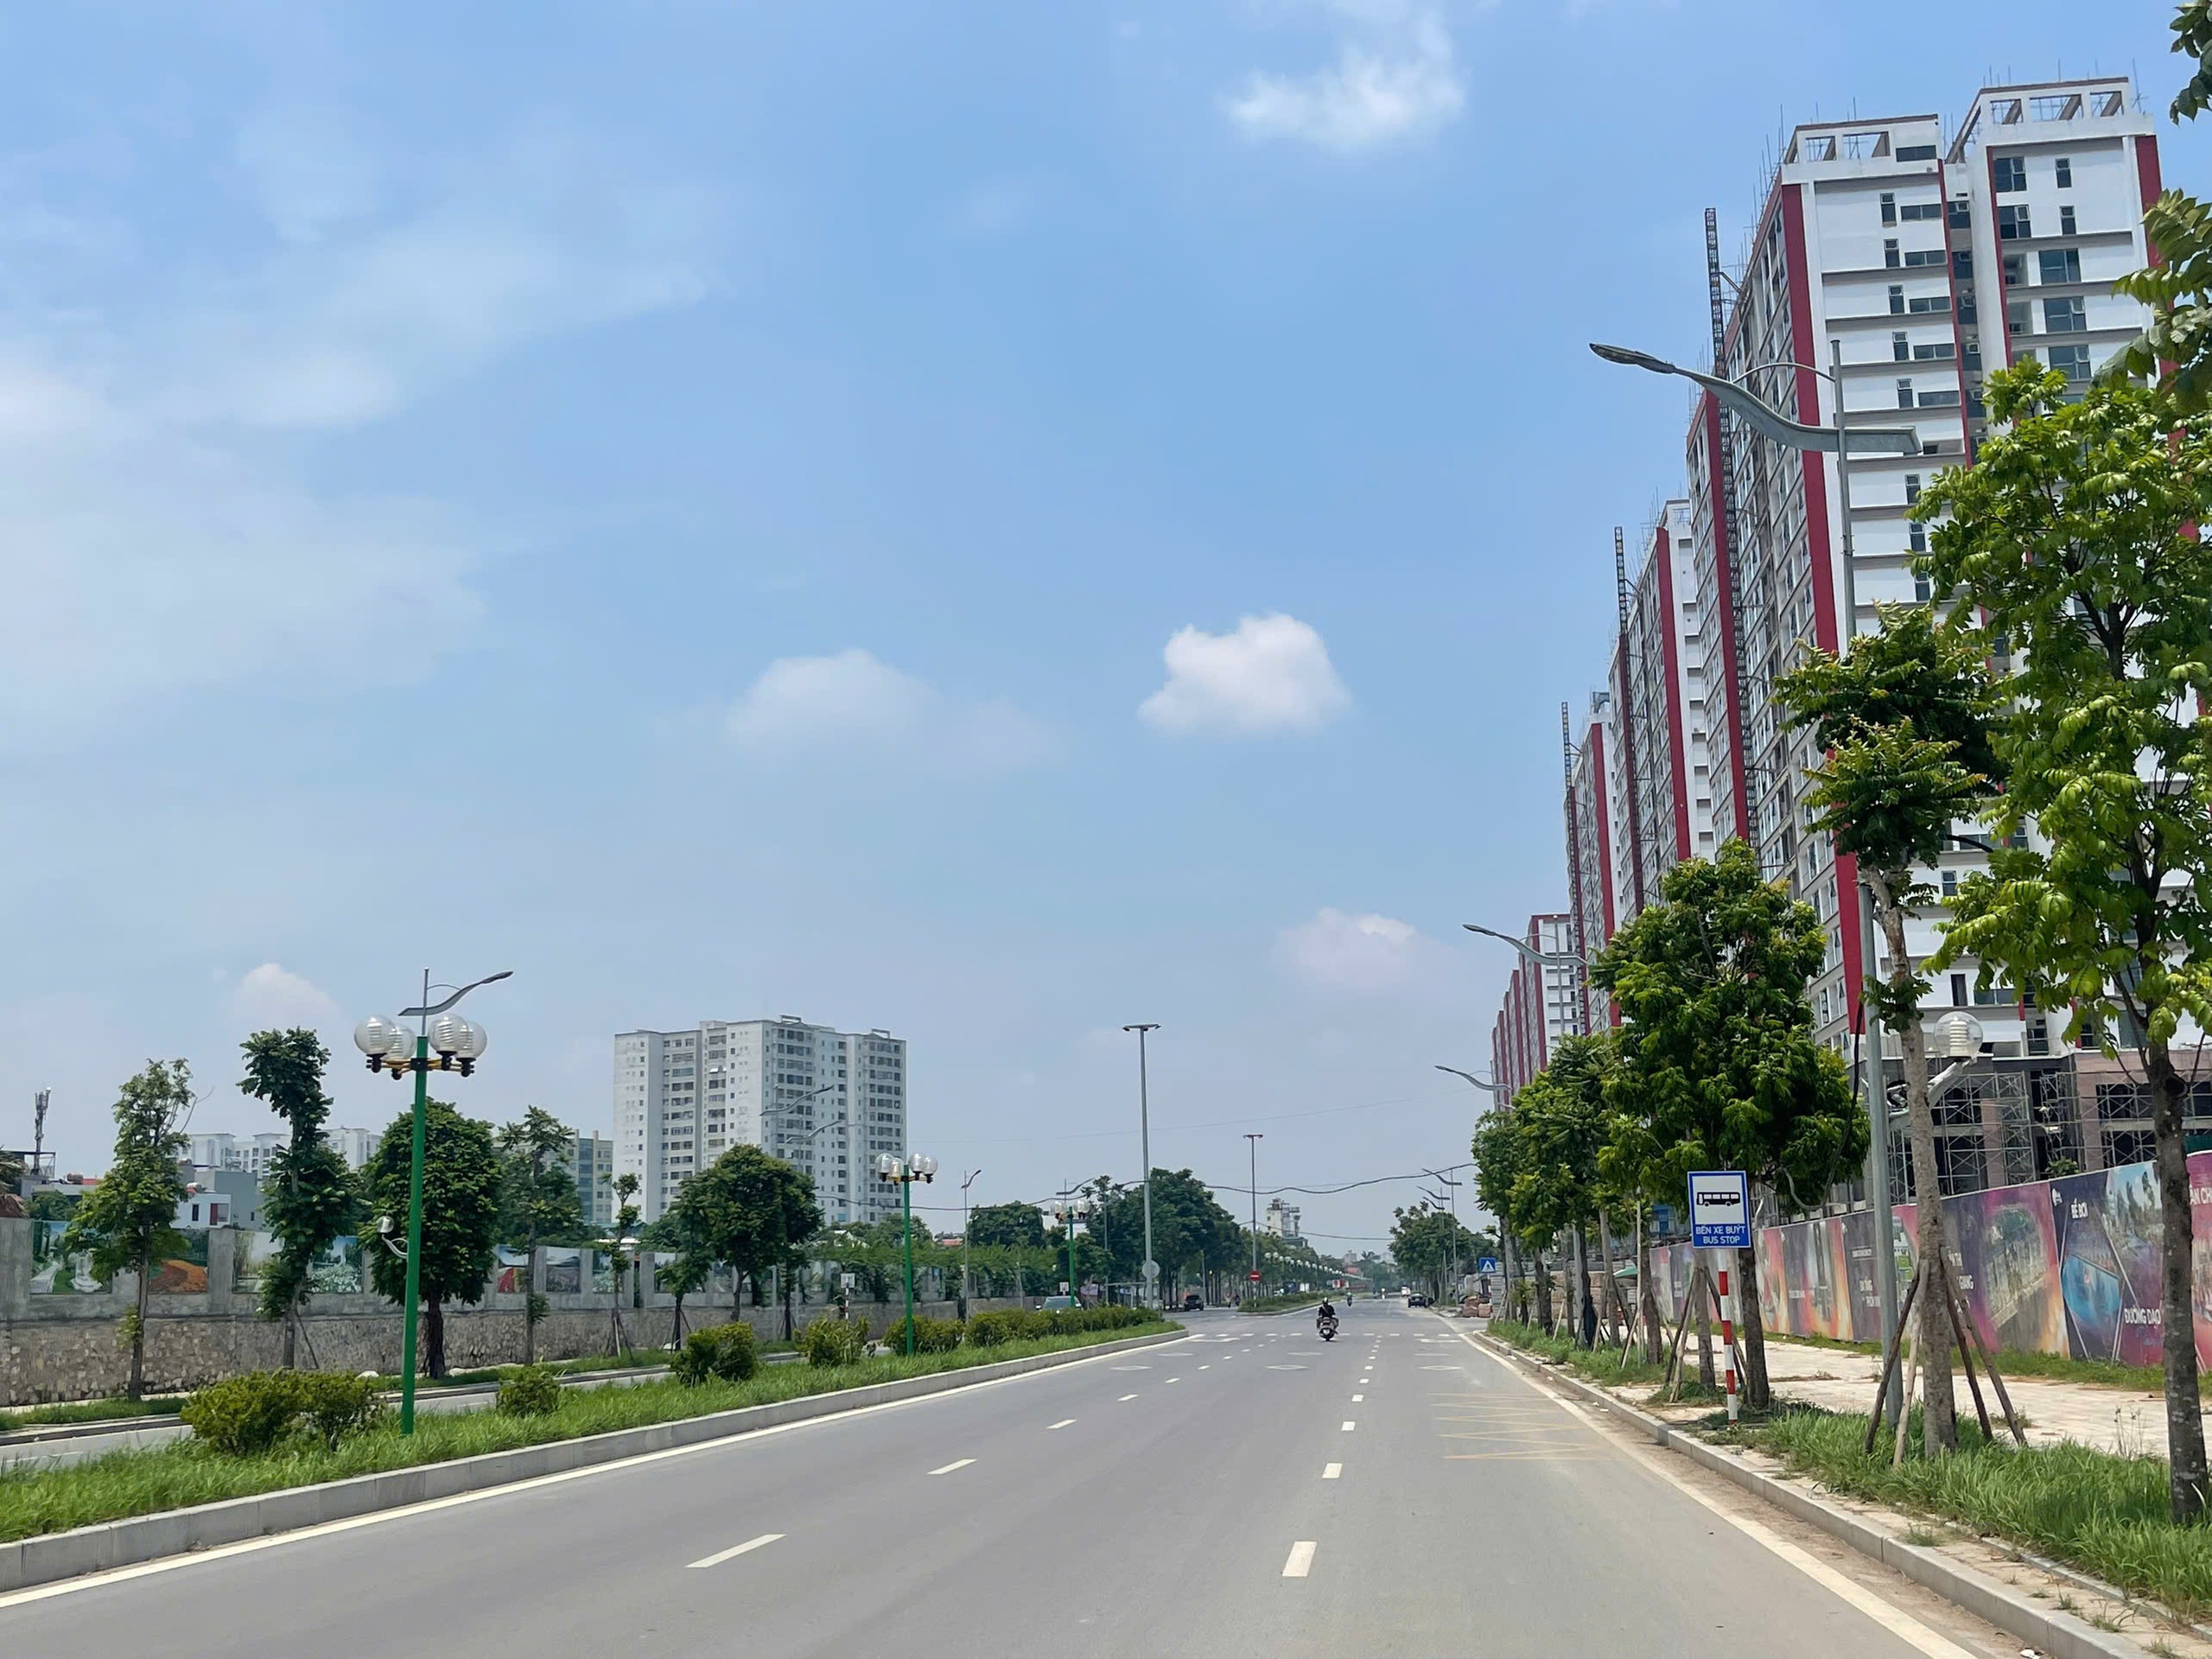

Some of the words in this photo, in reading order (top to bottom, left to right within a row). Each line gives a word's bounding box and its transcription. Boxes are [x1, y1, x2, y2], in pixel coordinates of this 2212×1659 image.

[1713, 1225, 1724, 1235] XE
[1726, 1224, 1745, 1235] BUÝT
[1703, 1236, 1719, 1244] BUS
[1719, 1236, 1740, 1244] STOP
